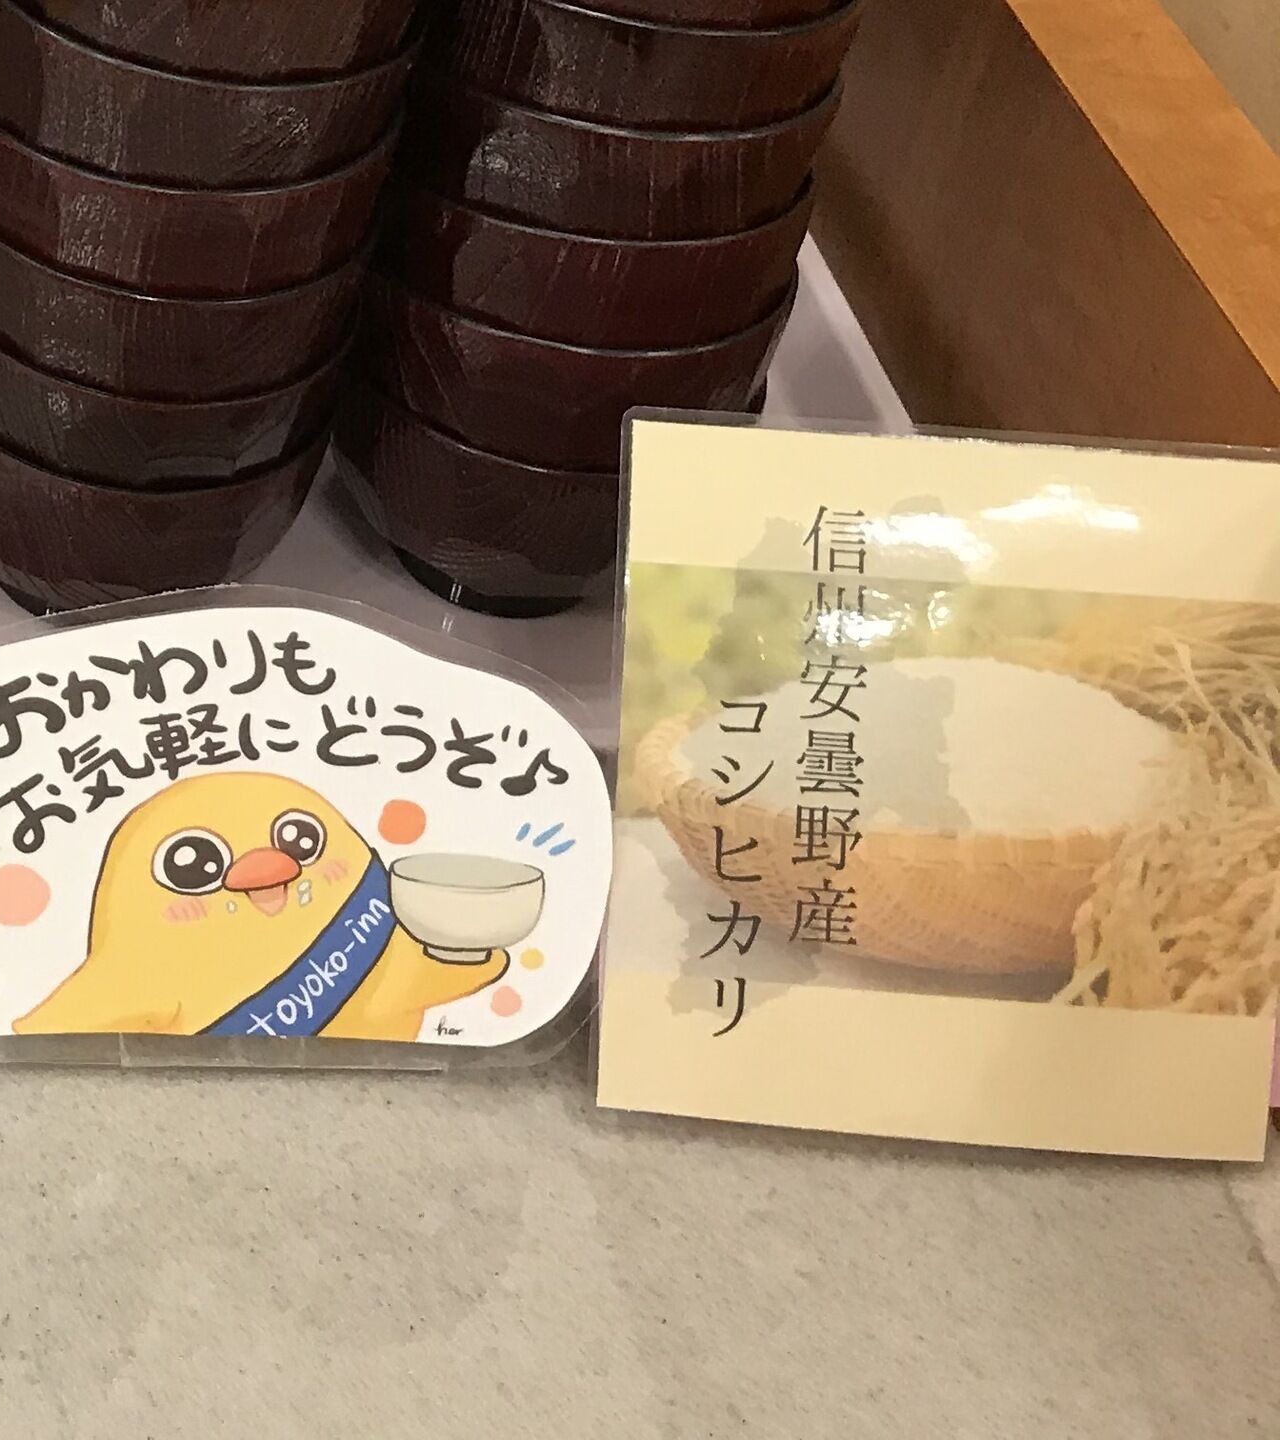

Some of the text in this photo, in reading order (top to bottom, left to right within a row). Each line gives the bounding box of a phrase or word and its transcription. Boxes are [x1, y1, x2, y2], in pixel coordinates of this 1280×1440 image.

[698, 697, 776, 1039] コシヒカリ
[787, 504, 868, 947] 信州安曇野産
[245, 897, 391, 1037] toyoko-inn
